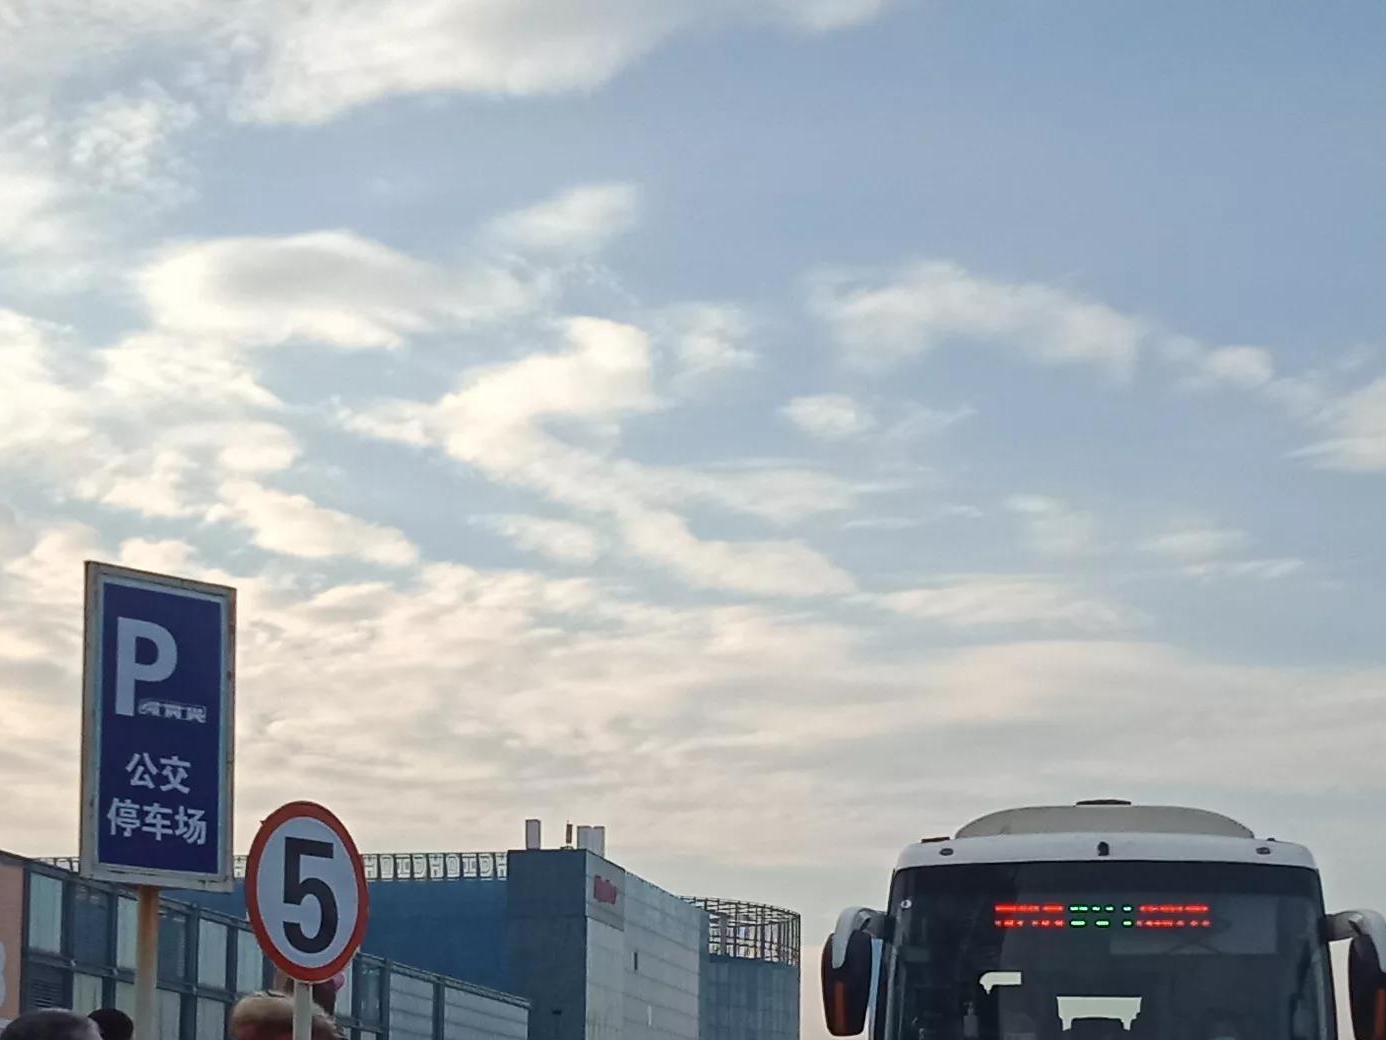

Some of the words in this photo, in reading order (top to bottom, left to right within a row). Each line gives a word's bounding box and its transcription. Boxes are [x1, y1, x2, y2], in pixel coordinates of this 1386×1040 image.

[114, 616, 178, 717] P
[125, 752, 192, 795] 公交
[106, 797, 208, 847] 停车场
[283, 836, 338, 954] 5
